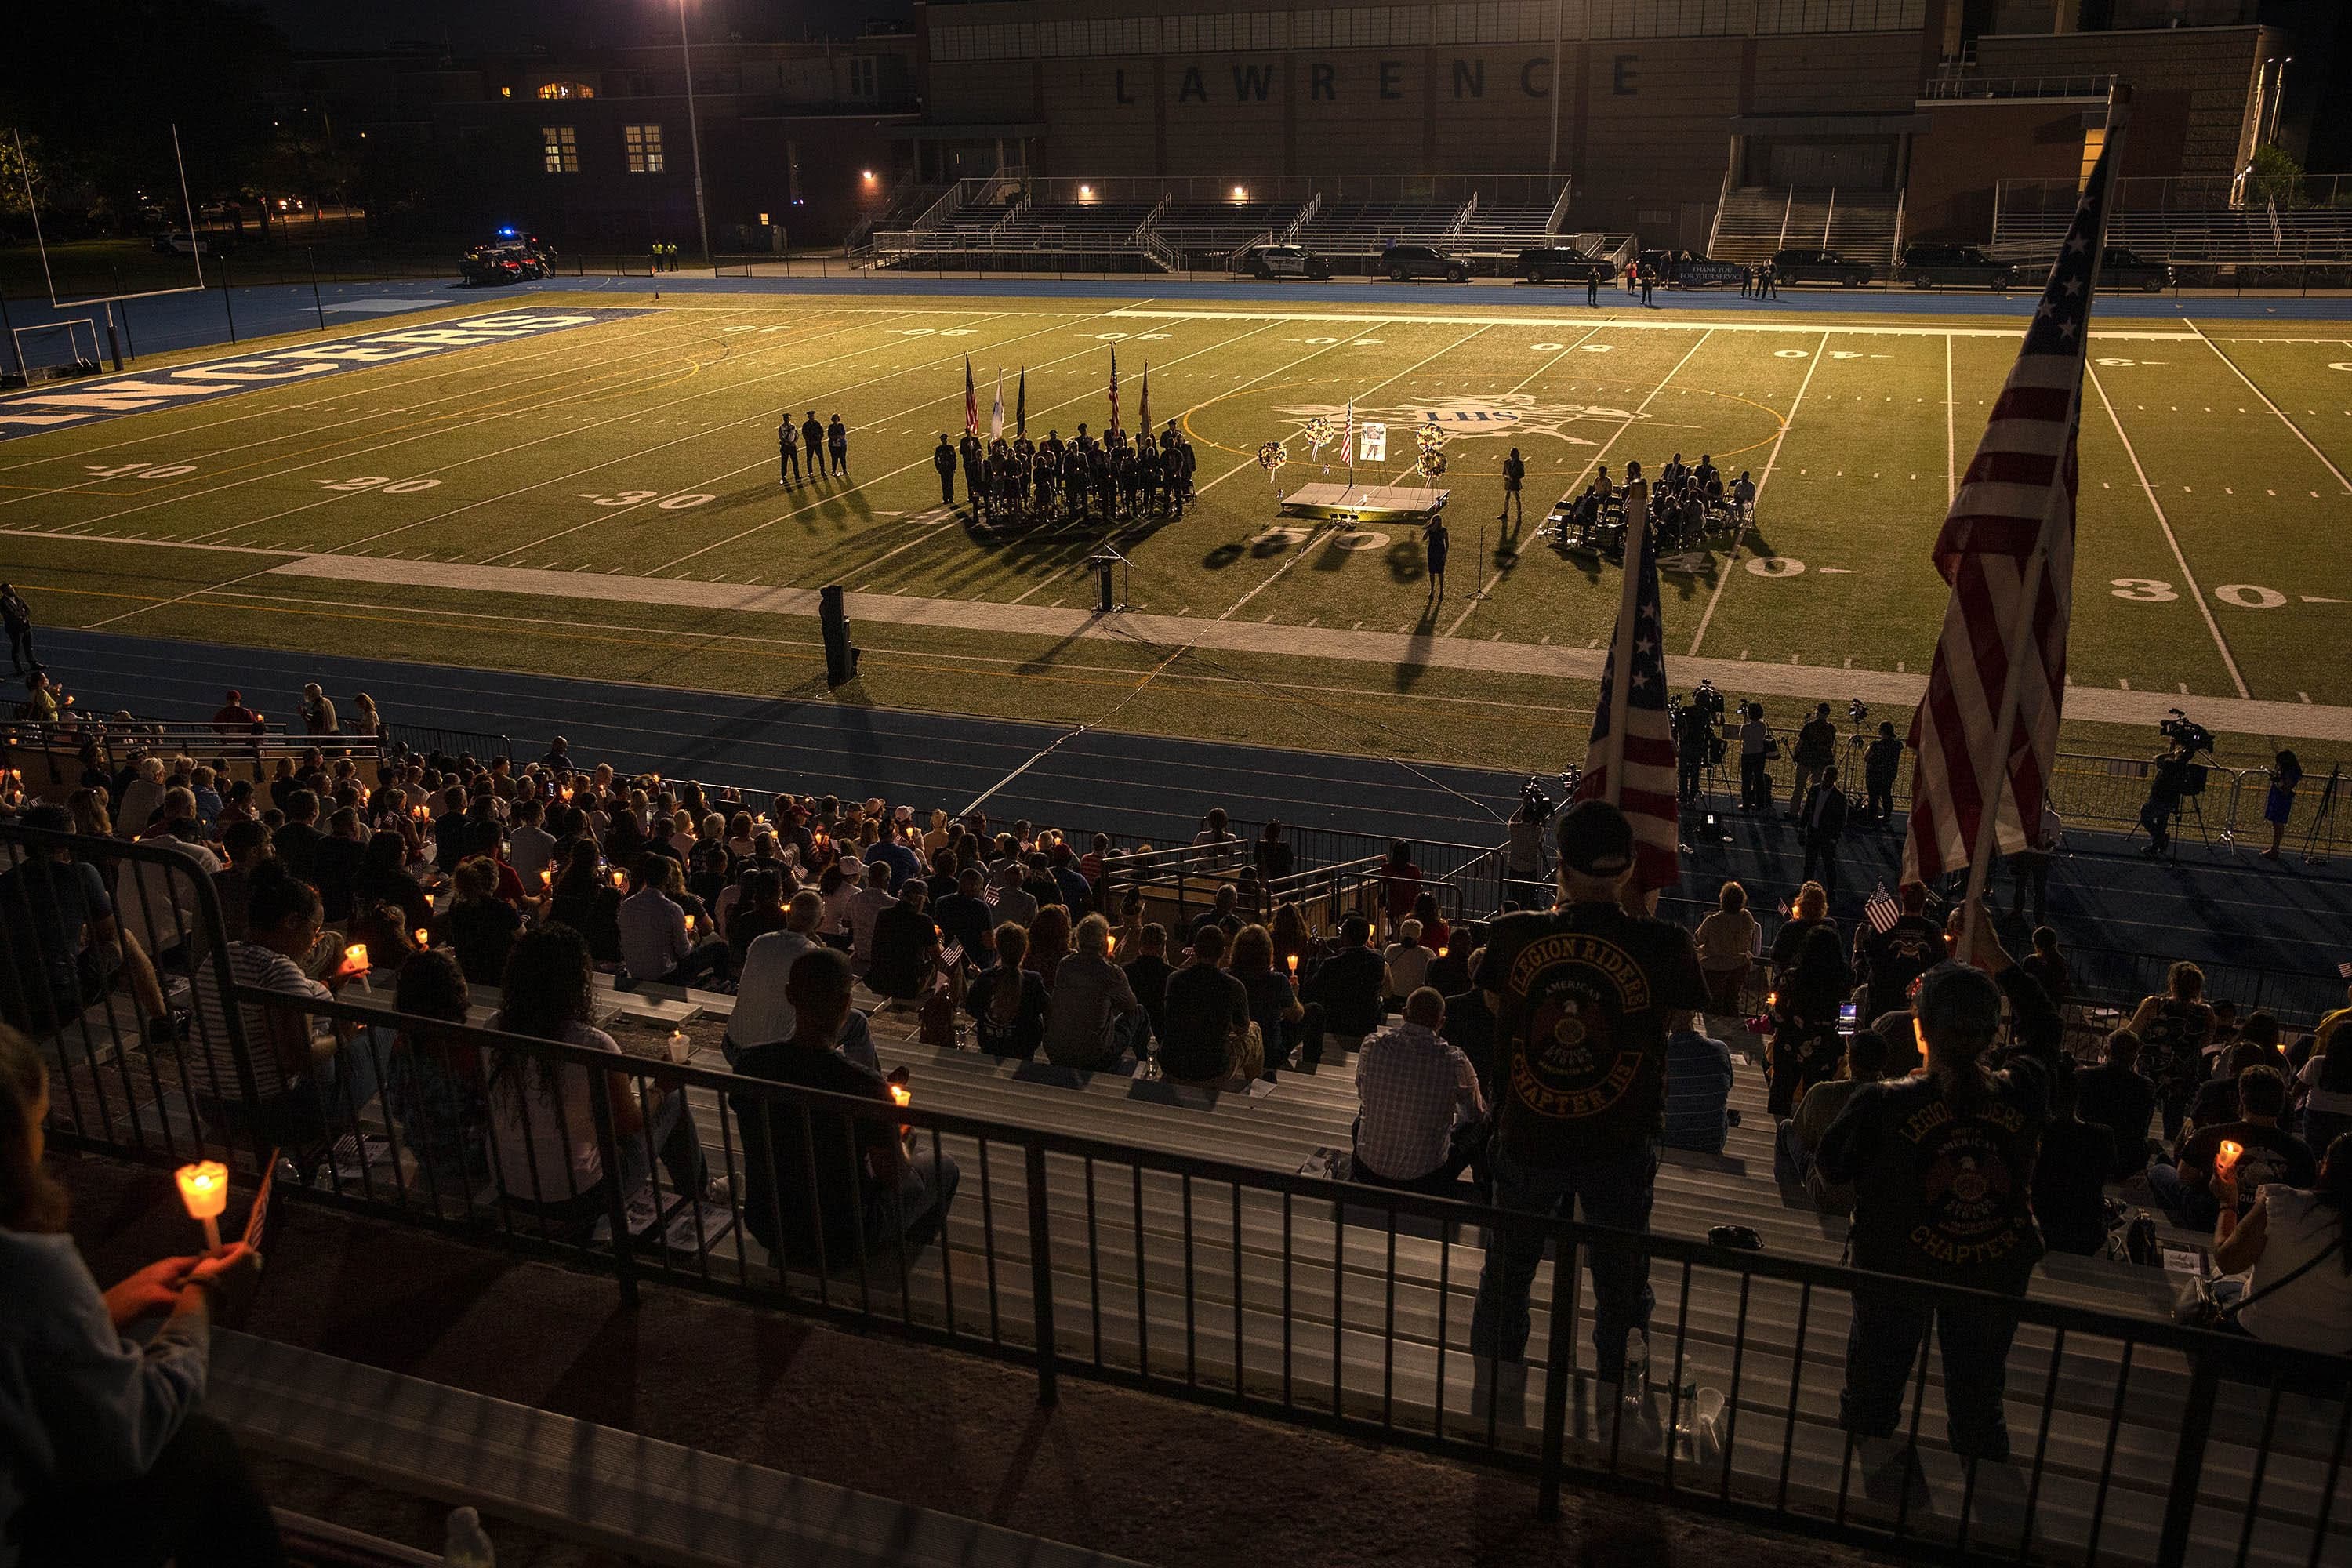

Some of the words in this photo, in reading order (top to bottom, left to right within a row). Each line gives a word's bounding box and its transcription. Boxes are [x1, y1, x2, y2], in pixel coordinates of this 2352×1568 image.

[1116, 54, 1639, 104] LAWRENCE
[1424, 411, 1519, 422] LHS
[88, 463, 198, 479] 10
[320, 477, 441, 494] 20
[593, 491, 716, 510] 30
[1250, 526, 1391, 550] 50
[2111, 578, 2288, 608] 30
[1513, 938, 1576, 989] LEGION
[1581, 938, 1645, 1005] RIDERS
[1512, 1052, 1606, 1113] CHAPTER
[1908, 1224, 2020, 1265] CHAPTER
